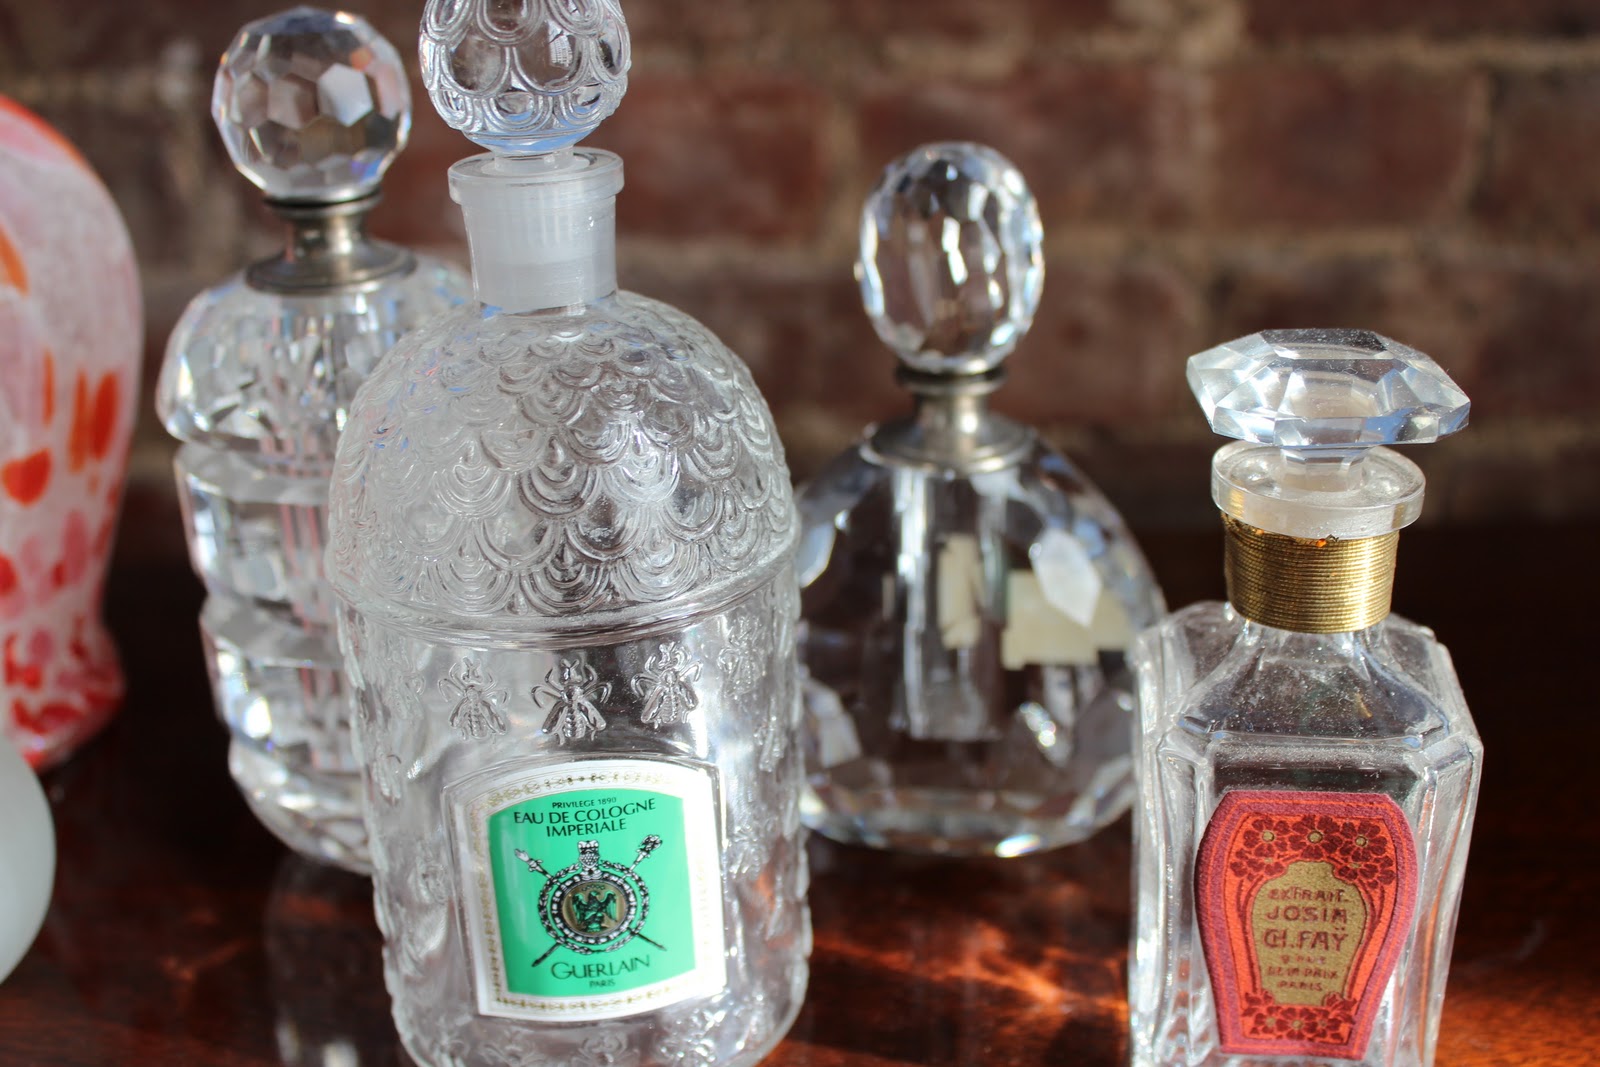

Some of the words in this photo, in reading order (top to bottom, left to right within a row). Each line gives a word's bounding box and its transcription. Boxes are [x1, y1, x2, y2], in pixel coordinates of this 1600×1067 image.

[514, 811, 544, 825] EAU
[550, 811, 569, 824] DE
[574, 798, 656, 823] COLOGNE
[552, 799, 595, 809] PRIVILEGE
[546, 818, 627, 837] IMPERIALE
[1267, 905, 1348, 924] JOSIA
[551, 955, 650, 980] GUERLAIN
[589, 978, 616, 988] PARIS
